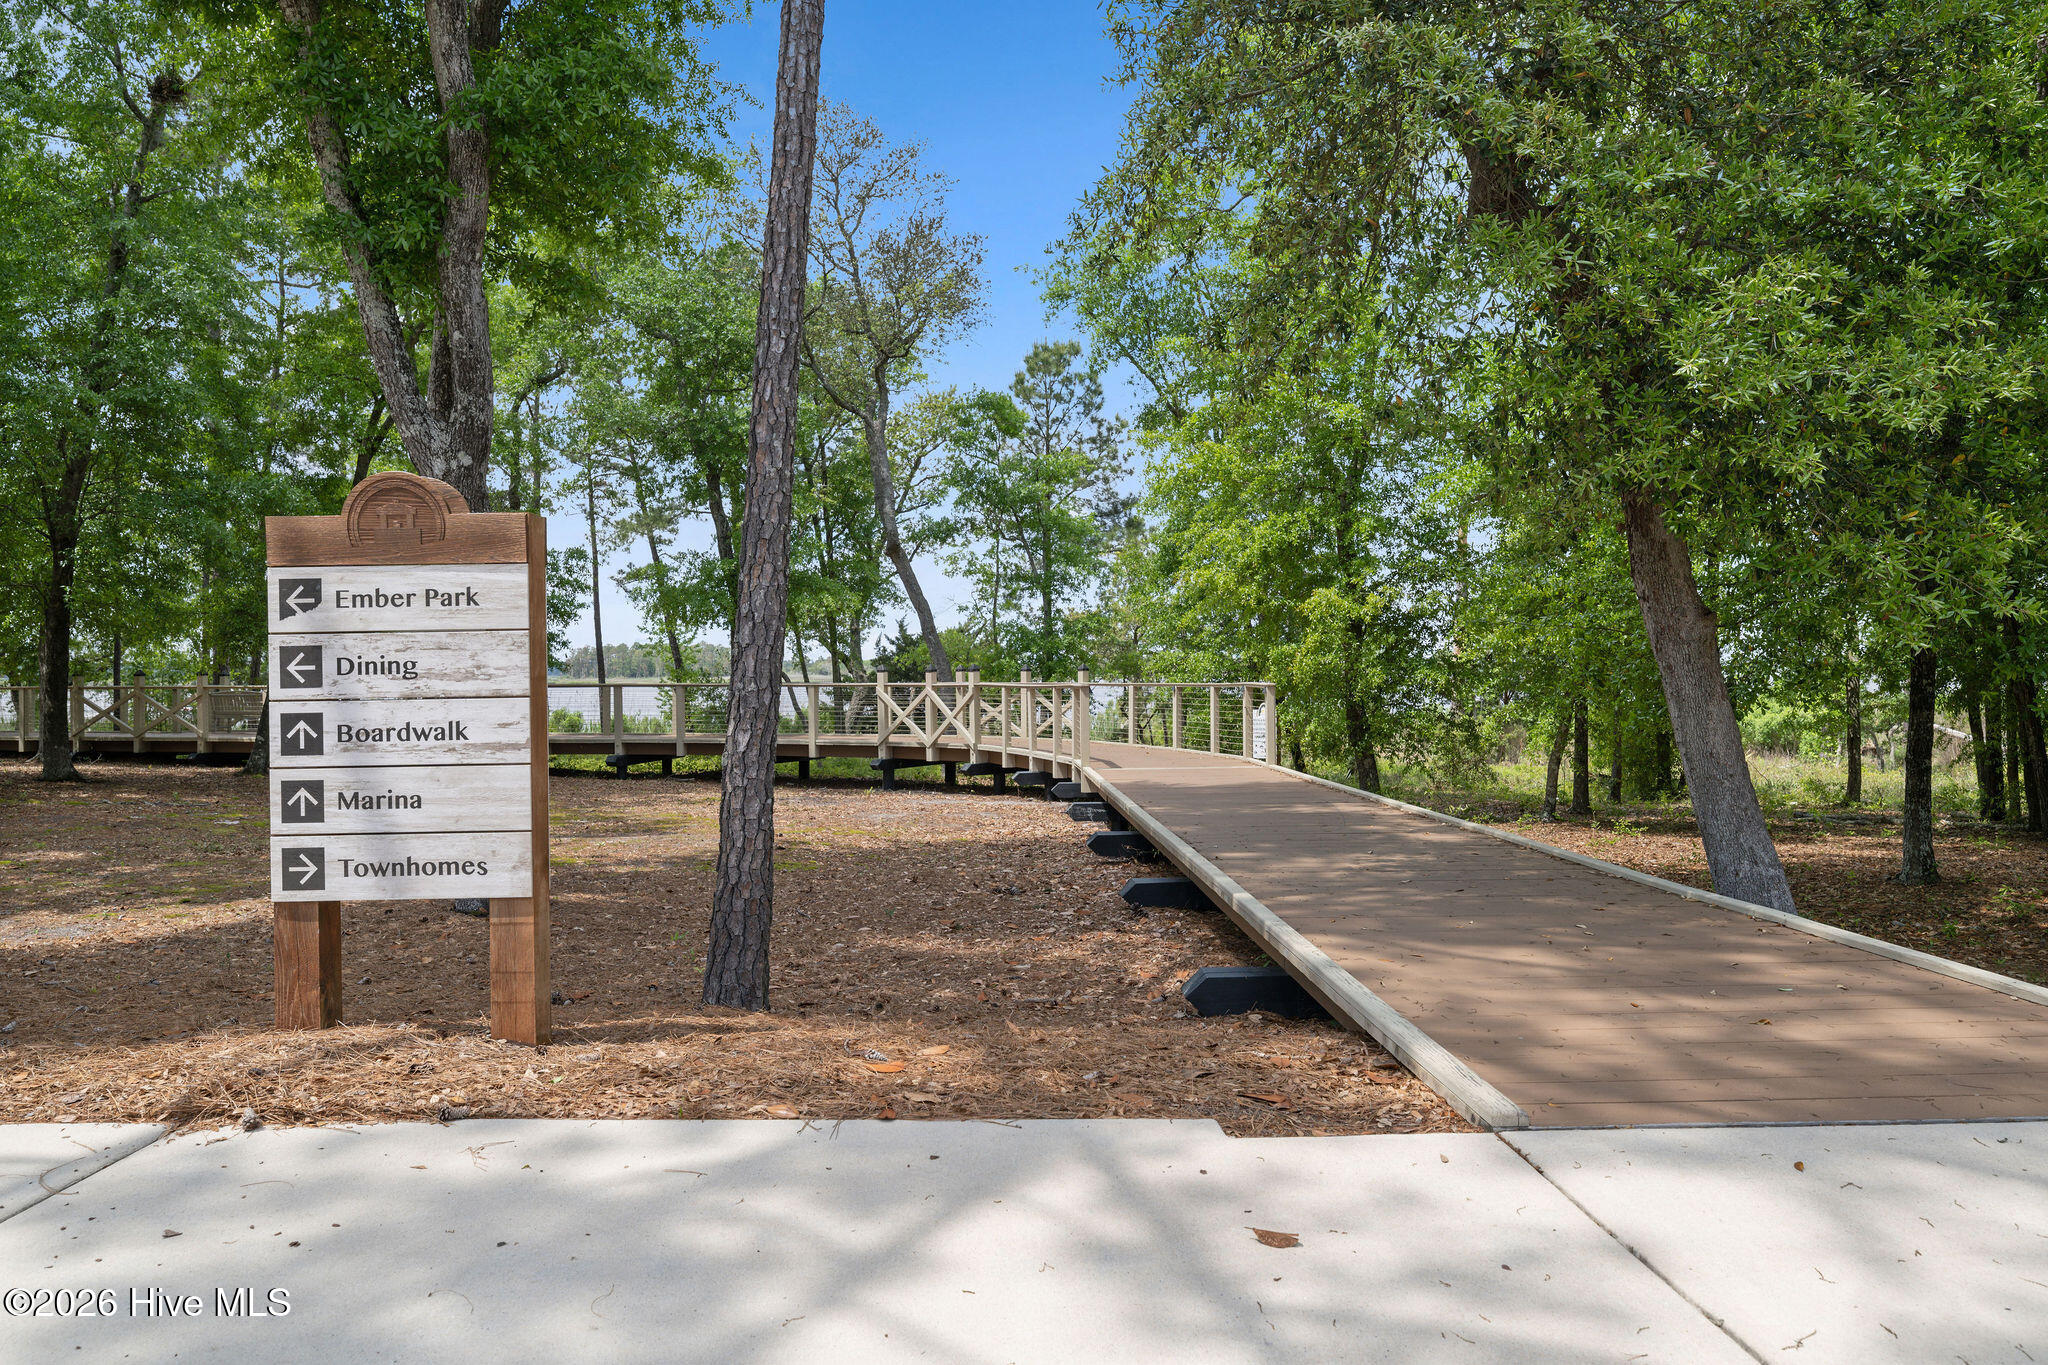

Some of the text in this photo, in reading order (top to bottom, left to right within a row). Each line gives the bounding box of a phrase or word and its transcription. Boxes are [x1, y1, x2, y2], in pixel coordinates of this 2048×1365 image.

[335, 586, 480, 609] Ember Park
[336, 654, 419, 681] Dining
[337, 720, 470, 743] Boardwalk
[338, 789, 423, 810] Marina
[337, 855, 489, 878] Townhomes
